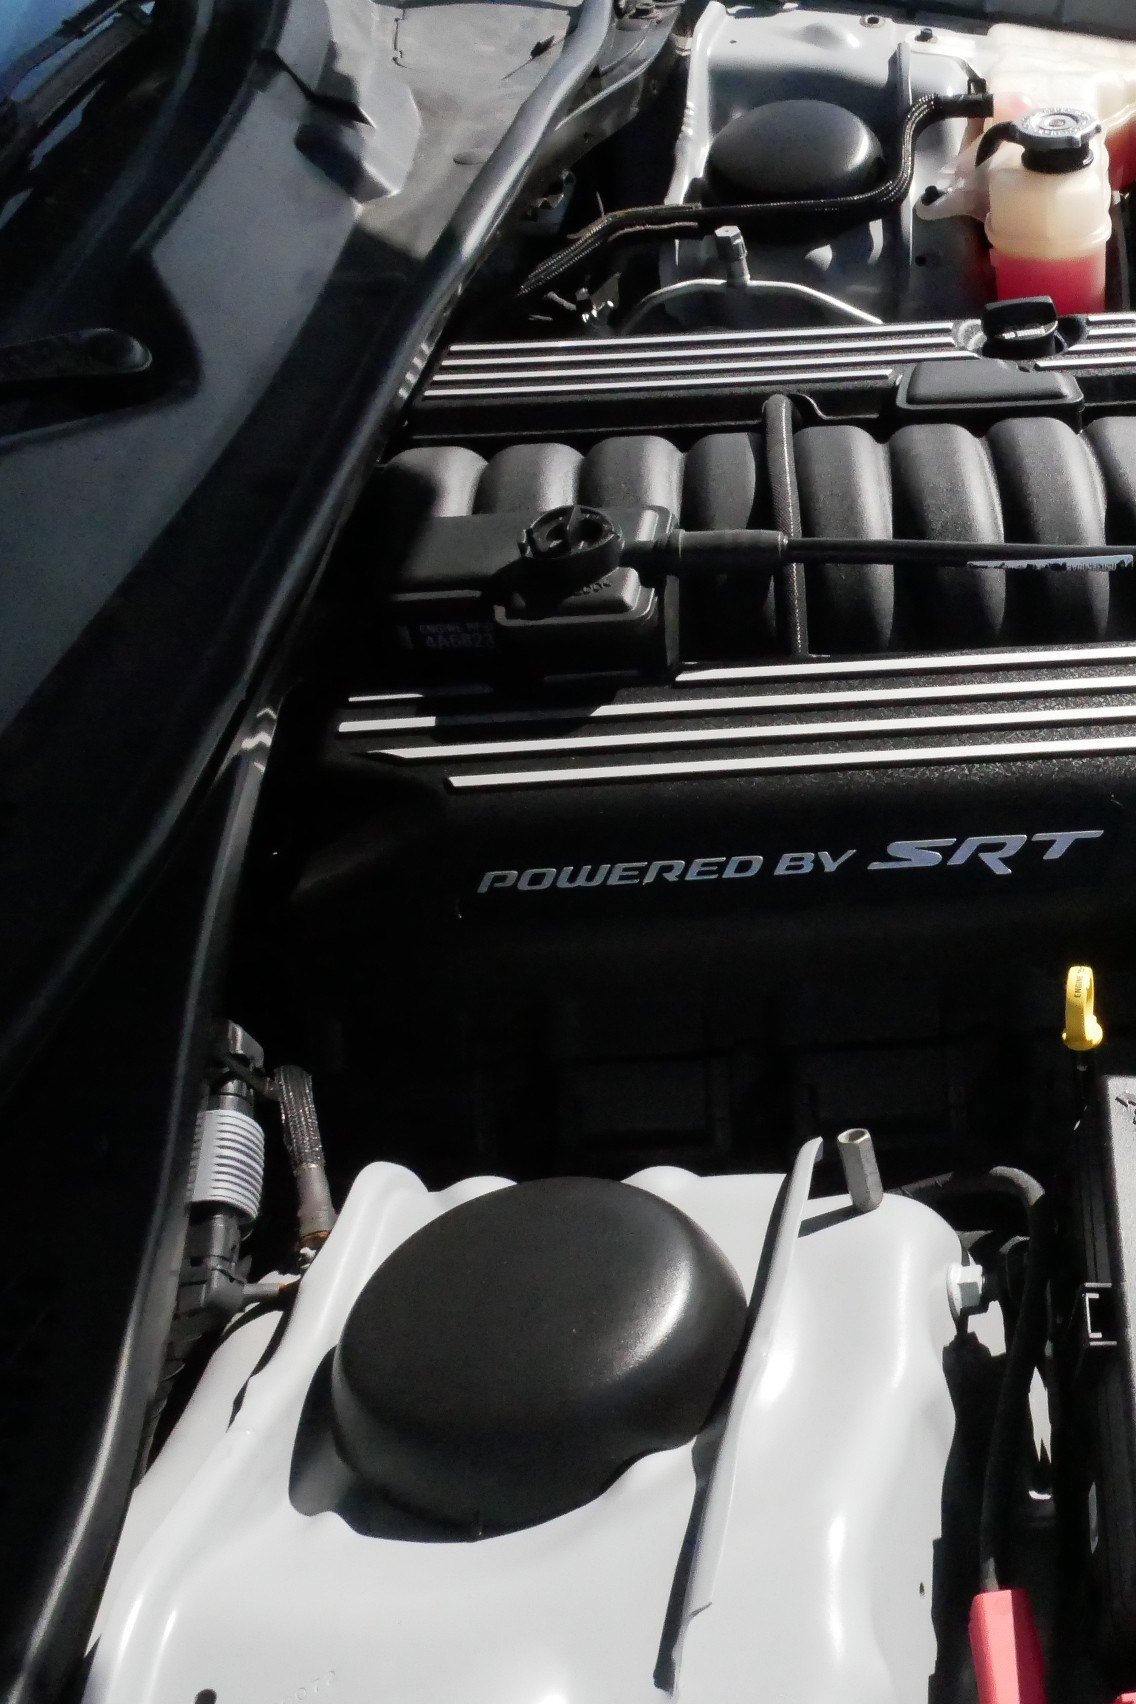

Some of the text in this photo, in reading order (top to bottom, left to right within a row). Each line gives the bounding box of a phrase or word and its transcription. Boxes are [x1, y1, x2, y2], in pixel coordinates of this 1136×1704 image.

[477, 829, 1104, 892] POWERED BY SRT
